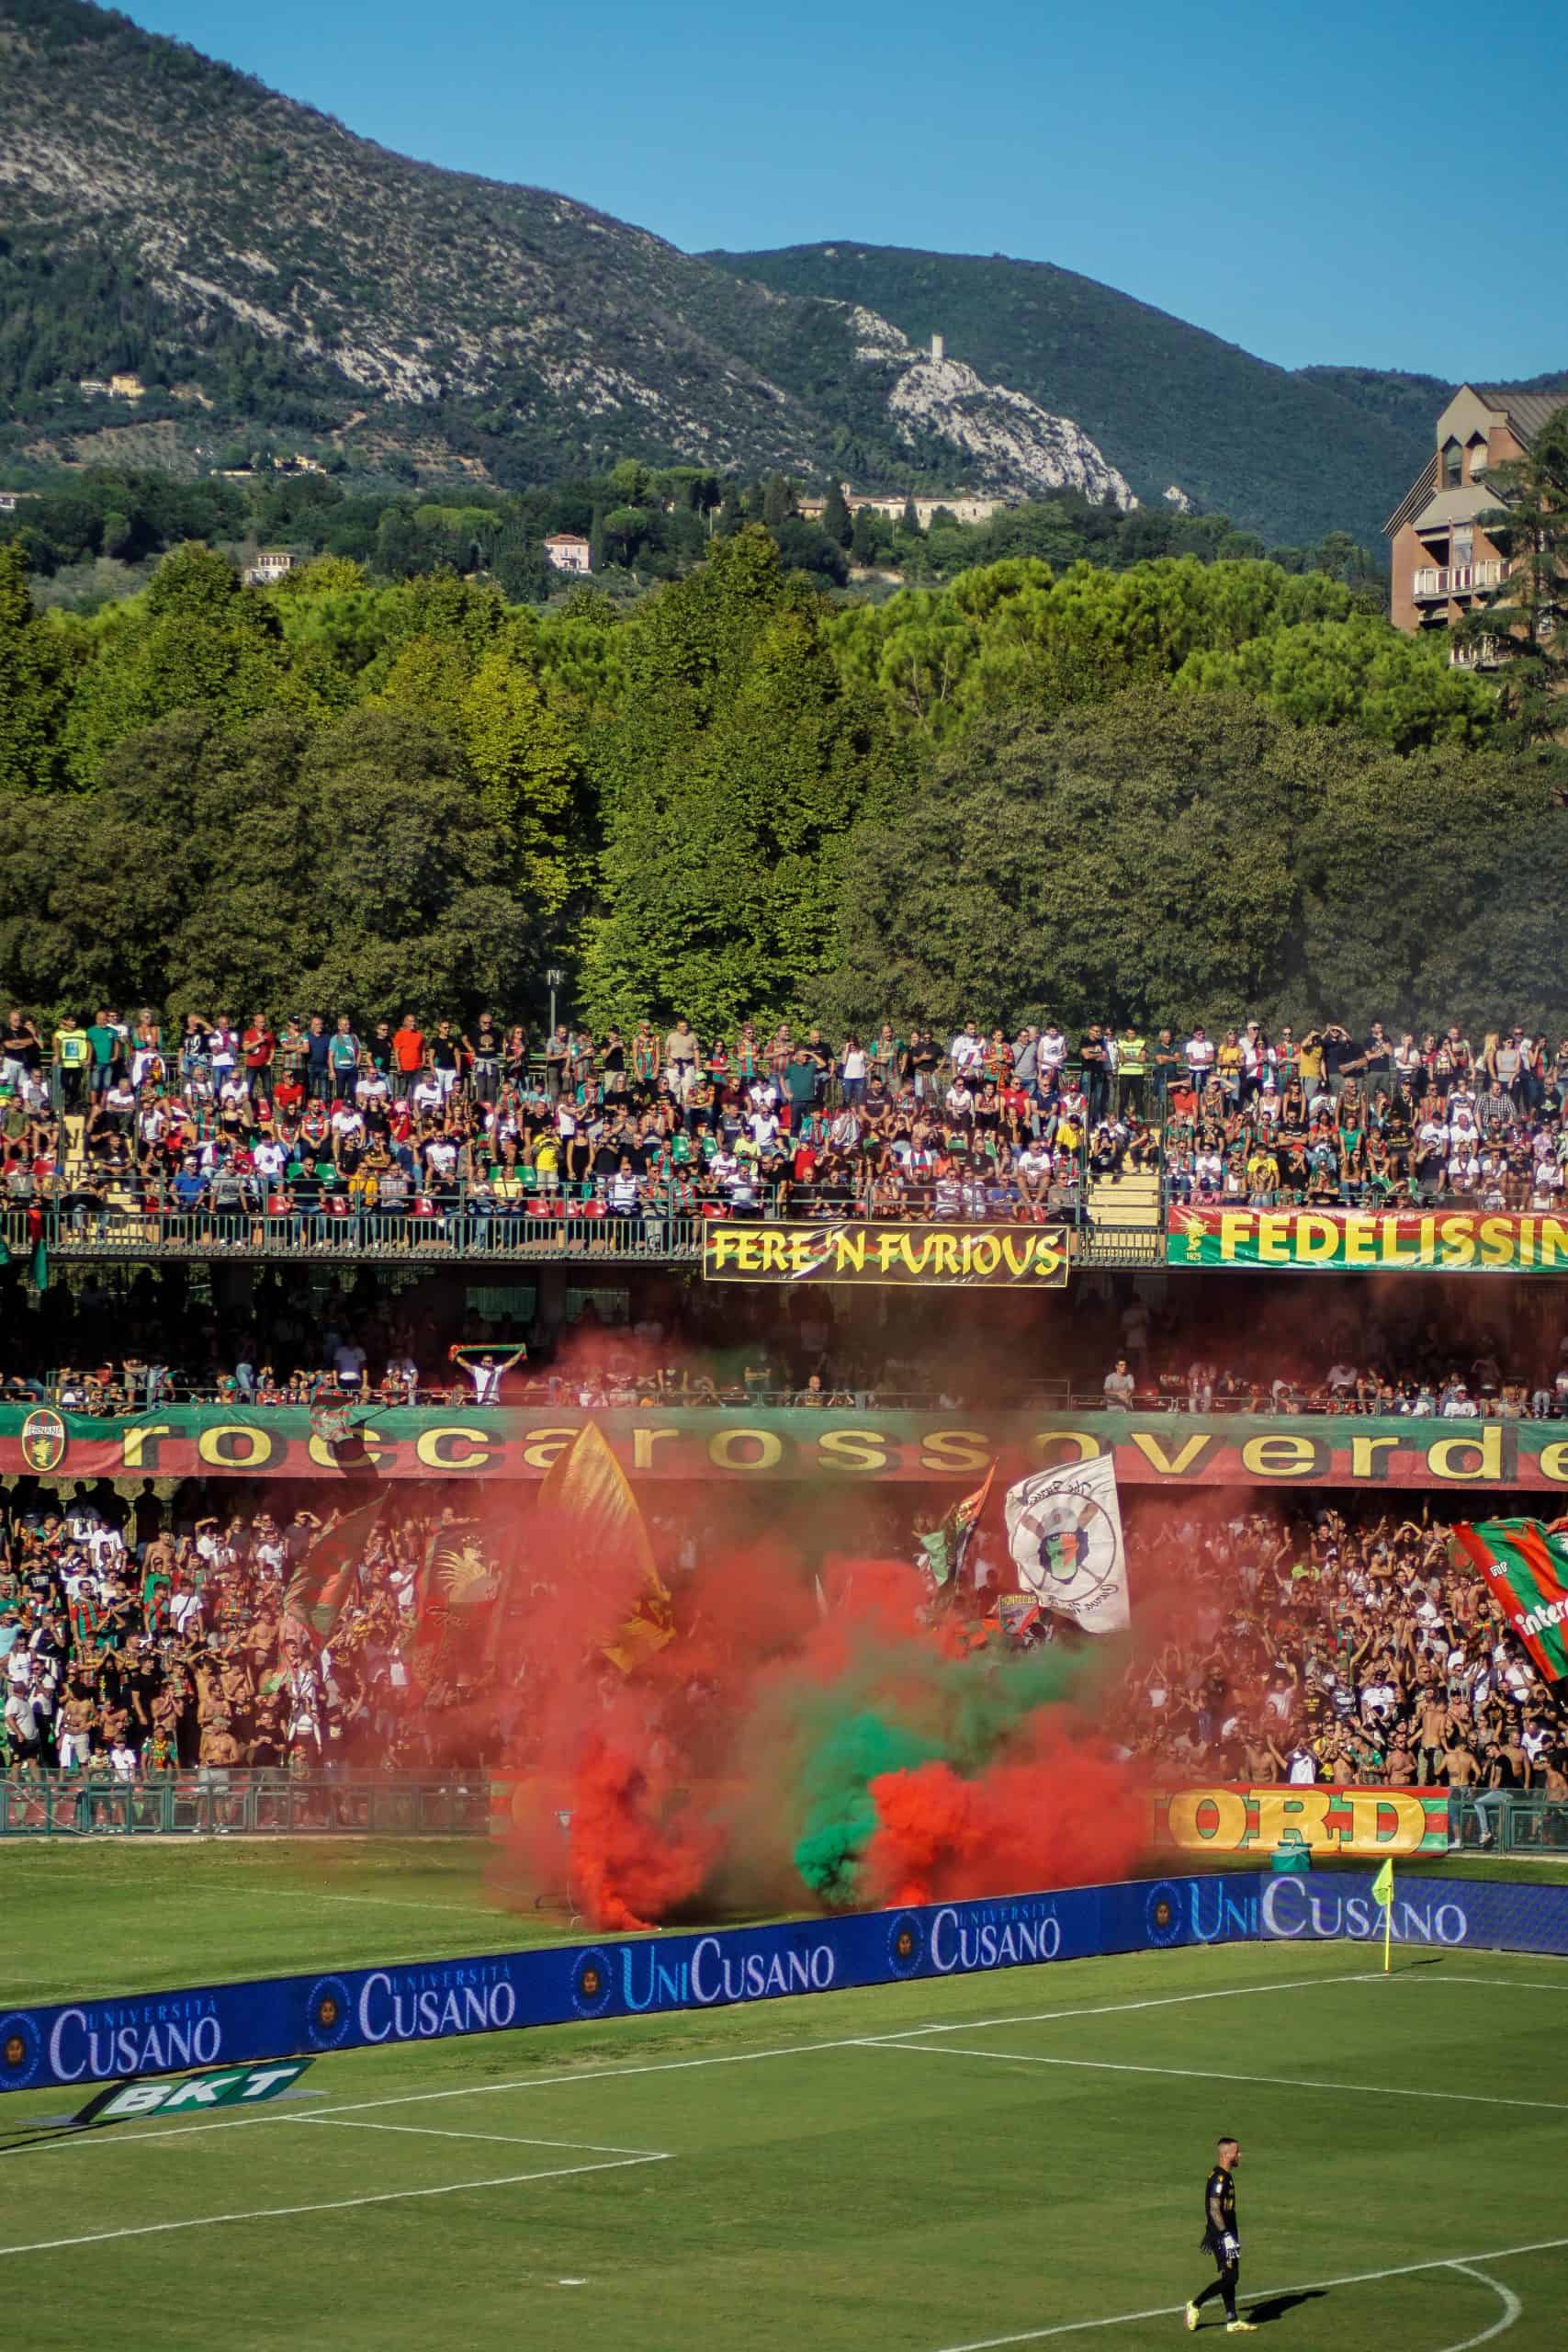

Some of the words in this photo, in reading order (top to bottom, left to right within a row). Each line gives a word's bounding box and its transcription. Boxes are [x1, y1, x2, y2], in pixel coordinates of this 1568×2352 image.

[711, 1228, 813, 1272] FERE
[877, 1233, 1060, 1276] FURIOUS
[1514, 1597, 1568, 1636] inter
[1146, 1788, 1427, 1856] ORD
[103, 2067, 300, 2115] BKT
